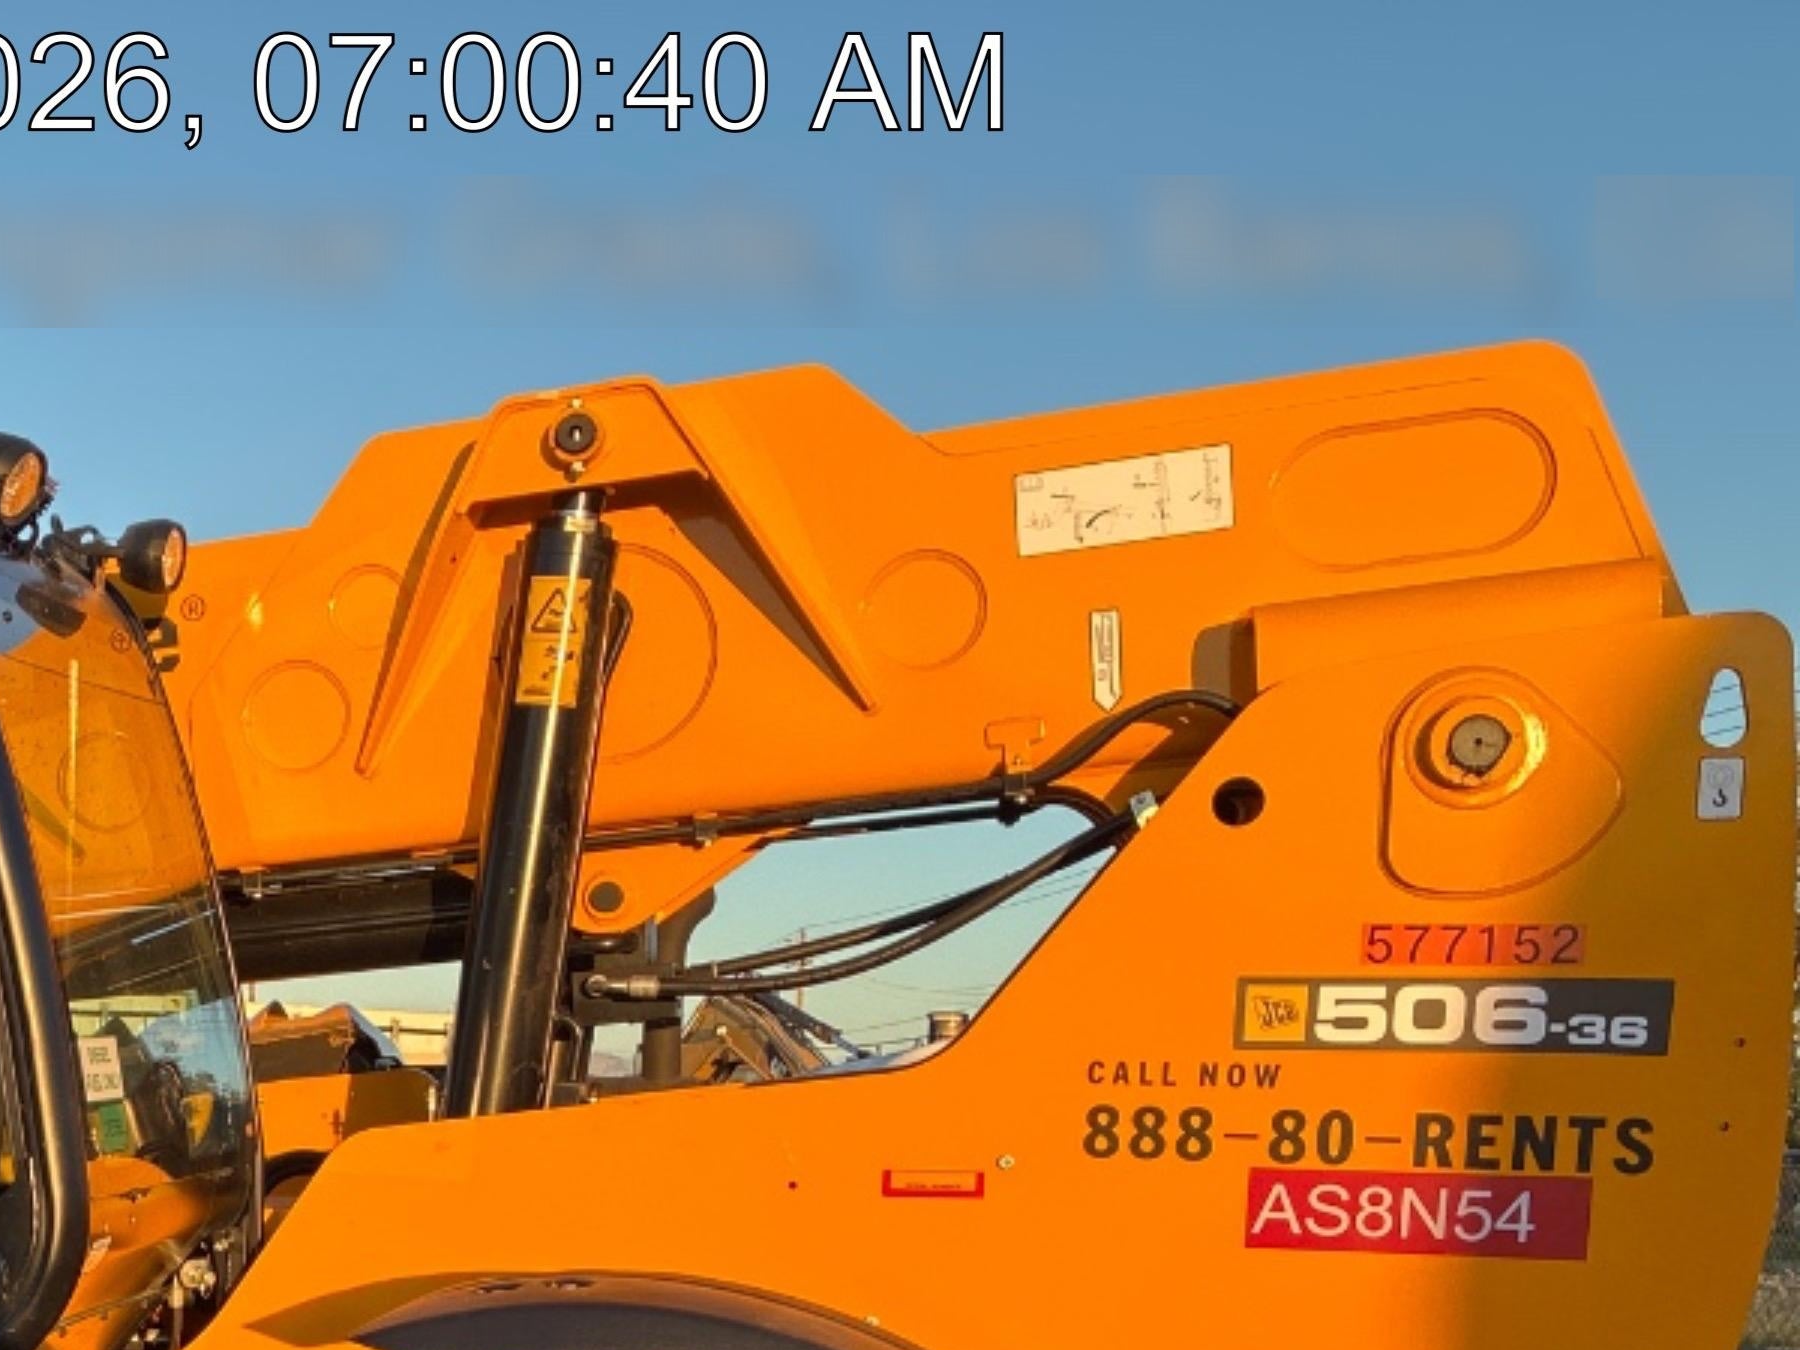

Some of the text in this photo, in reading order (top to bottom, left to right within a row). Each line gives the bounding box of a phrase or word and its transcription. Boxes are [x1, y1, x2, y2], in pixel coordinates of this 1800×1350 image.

[1366, 924, 1579, 964] 577152
[1313, 984, 1648, 1047] 506-36
[1087, 1061, 1281, 1088] CALL NOW
[1251, 1183, 1535, 1243] AS8N54
